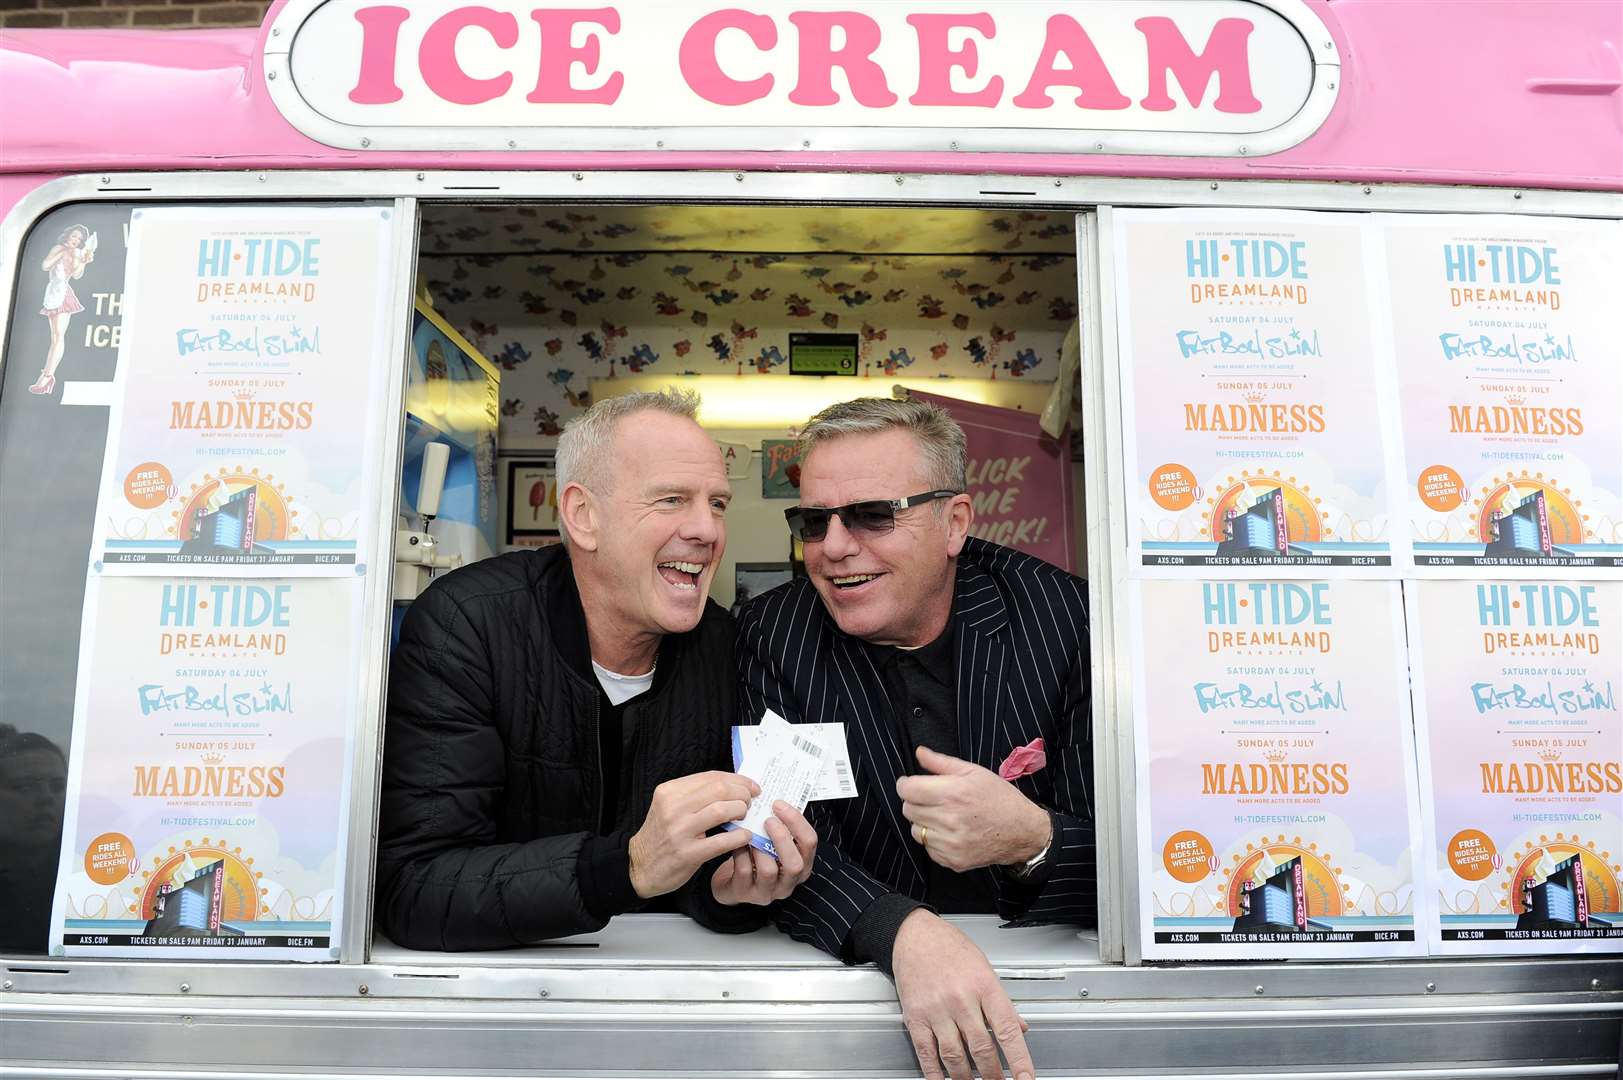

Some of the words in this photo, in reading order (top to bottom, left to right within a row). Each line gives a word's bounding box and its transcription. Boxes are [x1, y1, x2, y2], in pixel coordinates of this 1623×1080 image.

[348, 5, 625, 105] ICE
[678, 8, 1262, 114] CREAM
[197, 283, 315, 302] DREAMLAND
[1191, 284, 1307, 304] DREAMLAND
[1450, 288, 1560, 310] DREAMLAND
[169, 401, 312, 429] MADNESS
[1184, 403, 1326, 432] MADNESS
[1448, 405, 1584, 436] MADNESS
[966, 455, 1031, 486] LICK
[1160, 472, 1181, 481] FREE
[1428, 473, 1448, 482] FREE
[160, 633, 286, 655] DREAMLAND
[1209, 632, 1330, 653] DREAMLAND
[1484, 633, 1599, 654] DREAMLAND
[176, 742, 213, 750] SUNDAY
[218, 742, 229, 750] 05
[232, 742, 256, 750] JULY
[132, 766, 285, 798] MADNESS
[1201, 763, 1349, 795] MADNESS
[1480, 763, 1623, 794] MADNESS
[160, 817, 255, 825] HI-TIDEFESTIVAL.COM
[1234, 816, 1325, 824] HI-TIDEFESTIVAL.COM
[98, 842, 120, 852] FREE
[1176, 840, 1197, 850] FREE
[1455, 849, 1475, 857] RIDES
[1459, 839, 1480, 848] FREE
[93, 858, 127, 869] WEEKEND
[1171, 851, 1190, 859] RIDES
[1173, 855, 1206, 866] WEEKEND
[1457, 854, 1489, 865] WEEKEND
[1295, 864, 1304, 925] DREAMLAND
[1575, 863, 1585, 921] DREAMLAND
[80, 936, 108, 944] AXS.COM
[159, 937, 167, 945] ON
[169, 937, 185, 945] SALE
[187, 937, 200, 945] 9AM
[237, 938, 265, 946] JANUARY
[288, 938, 312, 946] DICE.FM
[1171, 934, 1199, 942] AXS.COM
[1221, 934, 1246, 942] TICKETS
[1292, 933, 1314, 941] FRIDAY
[1316, 933, 1324, 941] 31
